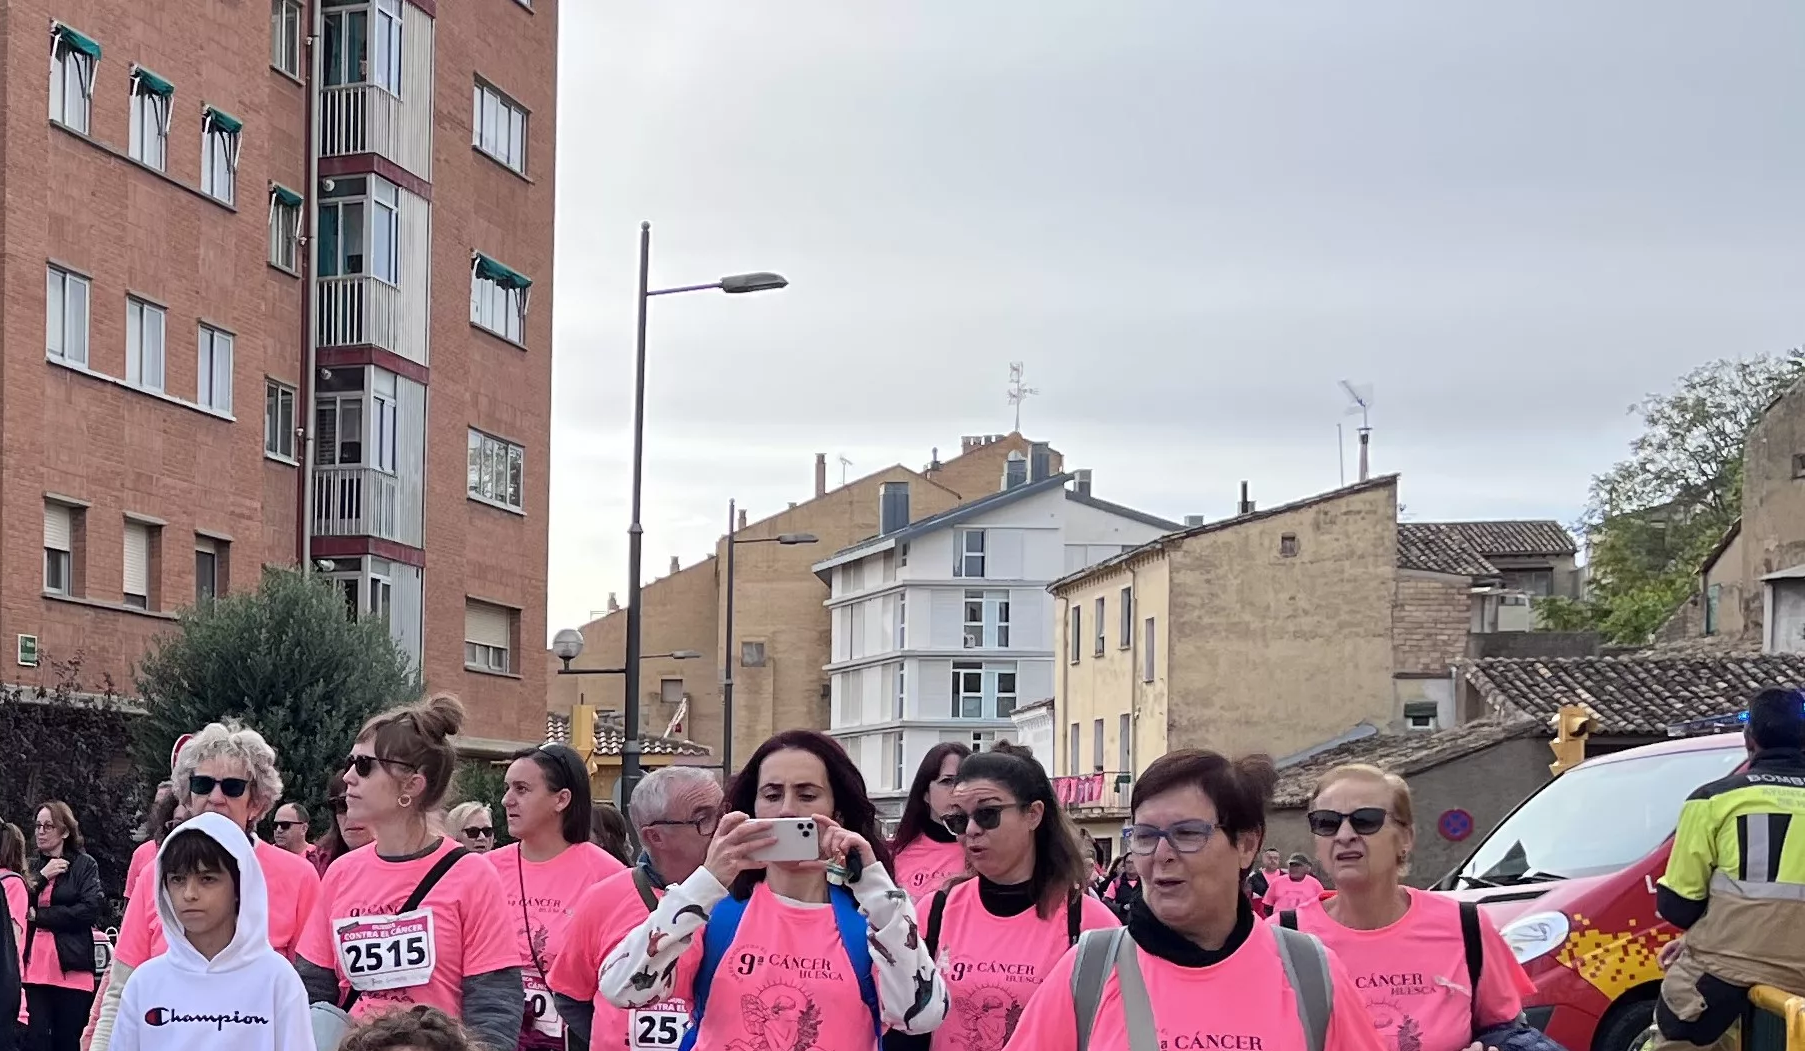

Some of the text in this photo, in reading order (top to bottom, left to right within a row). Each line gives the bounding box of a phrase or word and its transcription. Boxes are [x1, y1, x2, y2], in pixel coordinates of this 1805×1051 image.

[344, 923, 424, 941] CONTRA EL CÁNCER
[344, 936, 426, 974] 2515
[737, 953, 765, 976] 9ª
[768, 953, 831, 972] CÁNCER
[976, 960, 1035, 976] CÁNCER
[799, 969, 844, 982] HUESCA
[1355, 973, 1423, 989] CÁNCER
[1390, 985, 1437, 995] HUESCA
[144, 1006, 269, 1032] Champion
[1174, 1031, 1263, 1051] CÁNCER
